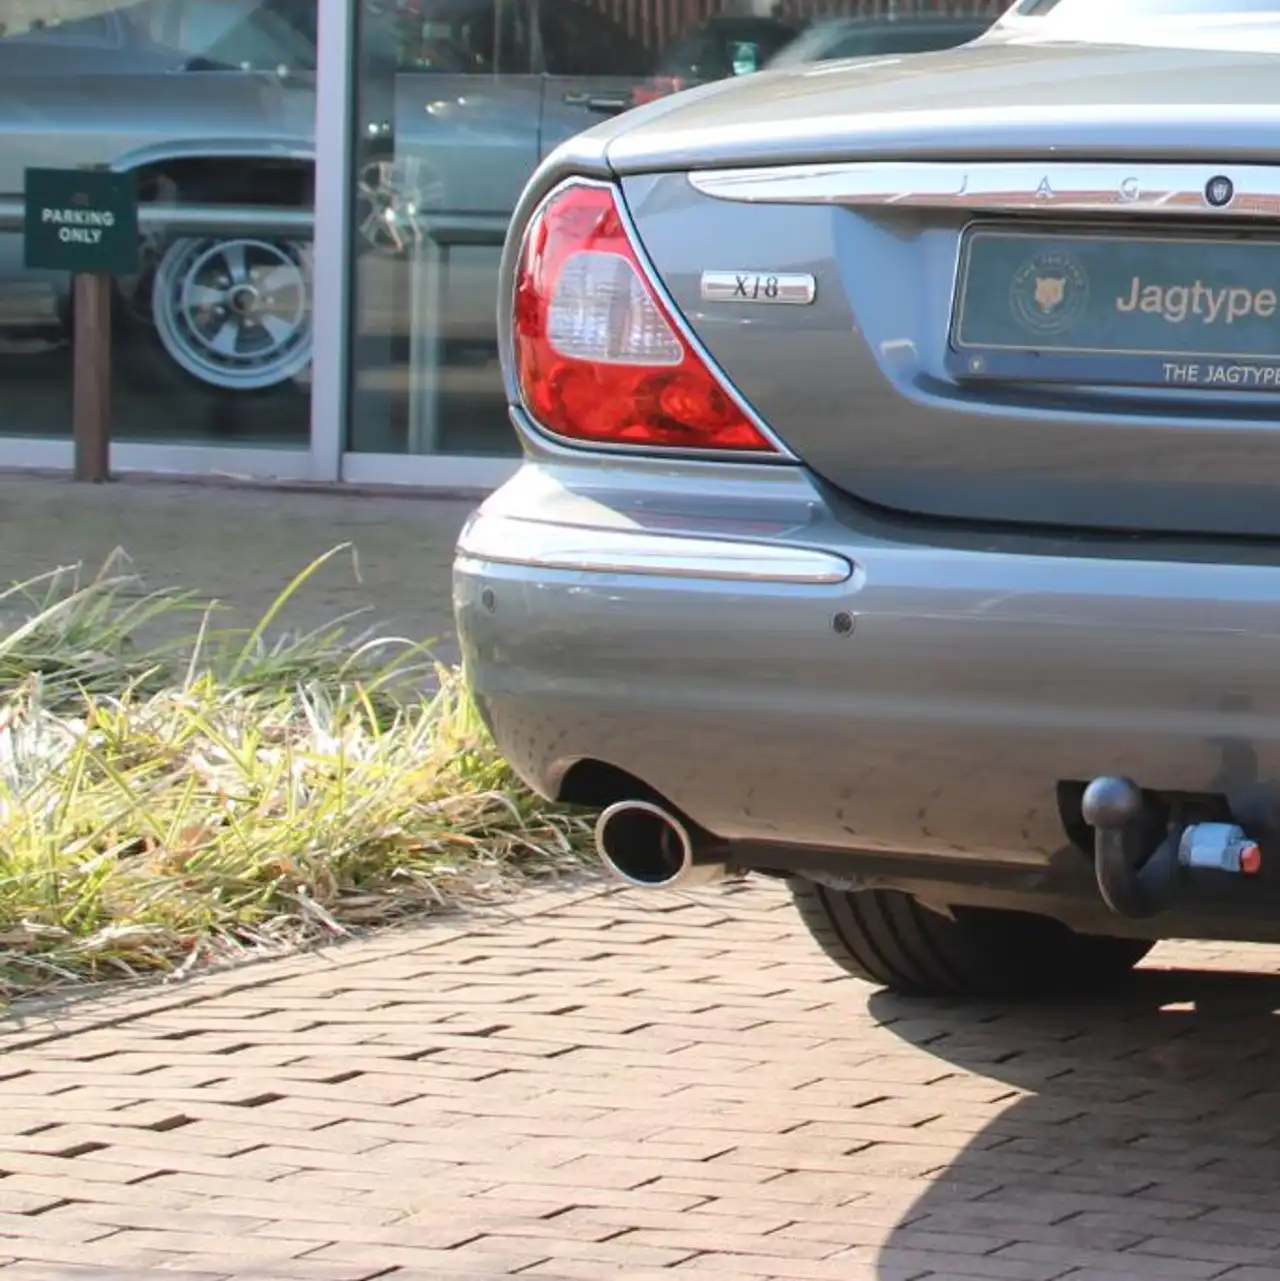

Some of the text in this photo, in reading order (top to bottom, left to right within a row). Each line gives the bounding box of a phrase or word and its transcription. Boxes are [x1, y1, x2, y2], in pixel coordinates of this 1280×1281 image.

[42, 208, 115, 226] PARKING
[58, 227, 102, 244] ONLY
[1116, 276, 1278, 324] Jagtype
[1162, 363, 1199, 384] THE
